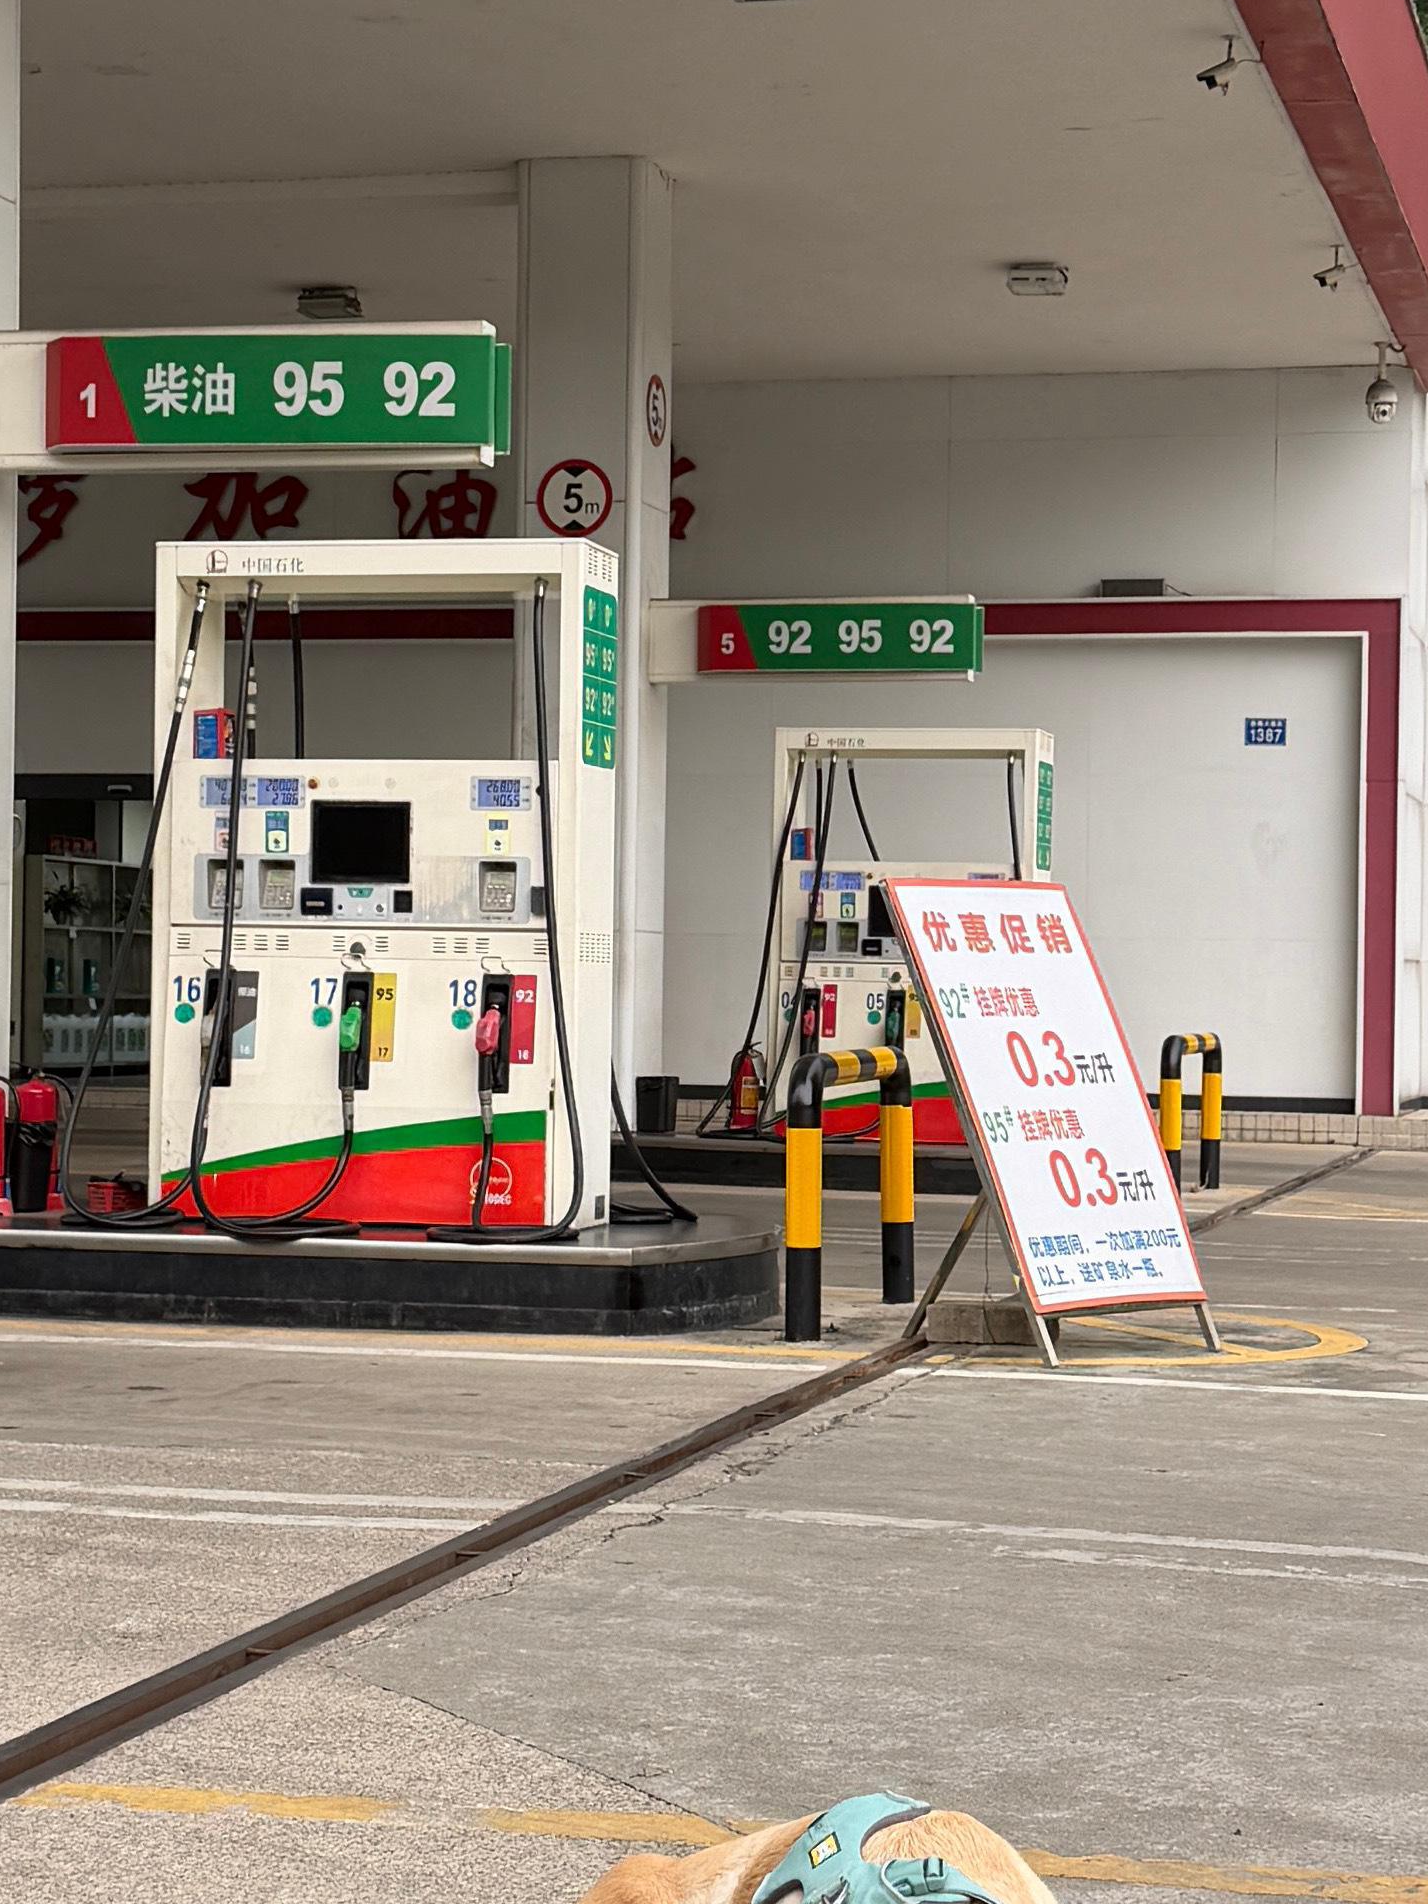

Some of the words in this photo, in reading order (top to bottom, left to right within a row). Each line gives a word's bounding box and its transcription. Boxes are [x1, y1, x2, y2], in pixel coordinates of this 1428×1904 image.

[80, 383, 96, 418] 1
[144, 362, 235, 417] 柴油
[274, 361, 345, 417] 95
[384, 361, 457, 417] 92
[564, 483, 600, 514] 5m
[242, 557, 304, 573] 中国石化
[721, 633, 735, 654] 5
[768, 620, 813, 654] 92
[838, 619, 882, 653] 95
[909, 619, 954, 653] 92
[922, 911, 1073, 954] 优惠促销
[173, 976, 201, 1002] 16
[310, 977, 338, 1005] 17
[449, 980, 477, 1008] 18
[376, 988, 394, 1001] 95
[515, 989, 534, 1003] 92
[867, 993, 884, 1010] 05
[972, 986, 1040, 1017] 挂牌优惠
[378, 1047, 388, 1057] 17
[1017, 1108, 1085, 1141] 挂牌优惠
